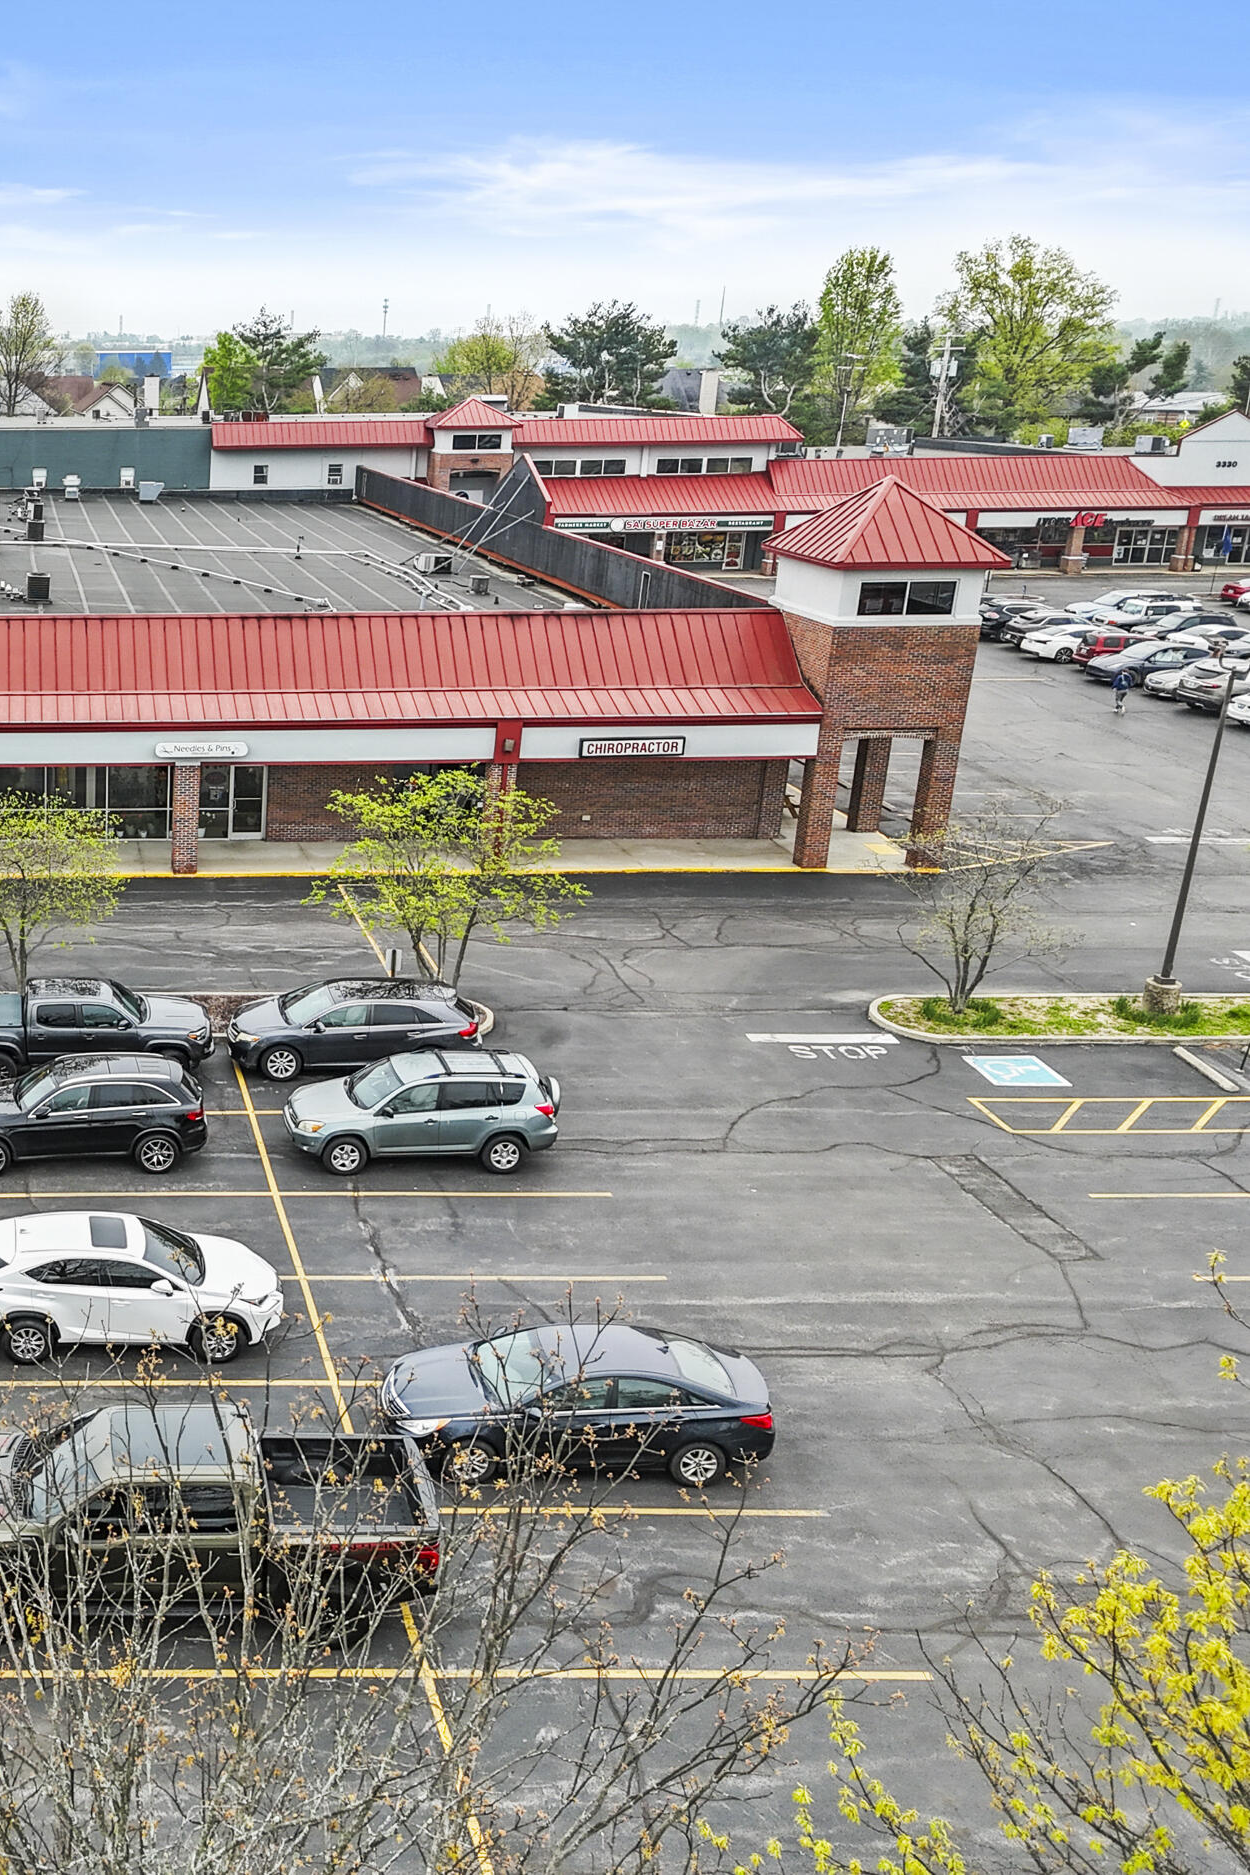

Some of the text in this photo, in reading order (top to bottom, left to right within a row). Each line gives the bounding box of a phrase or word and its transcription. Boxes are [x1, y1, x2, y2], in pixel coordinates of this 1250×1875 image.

[626, 519, 717, 530] SAI SUPER BAZAR
[1070, 511, 1107, 527] ACE
[215, 744, 231, 752] Pins
[587, 741, 679, 755] CHIROPRACTOR
[787, 1045, 888, 1060] STOP
